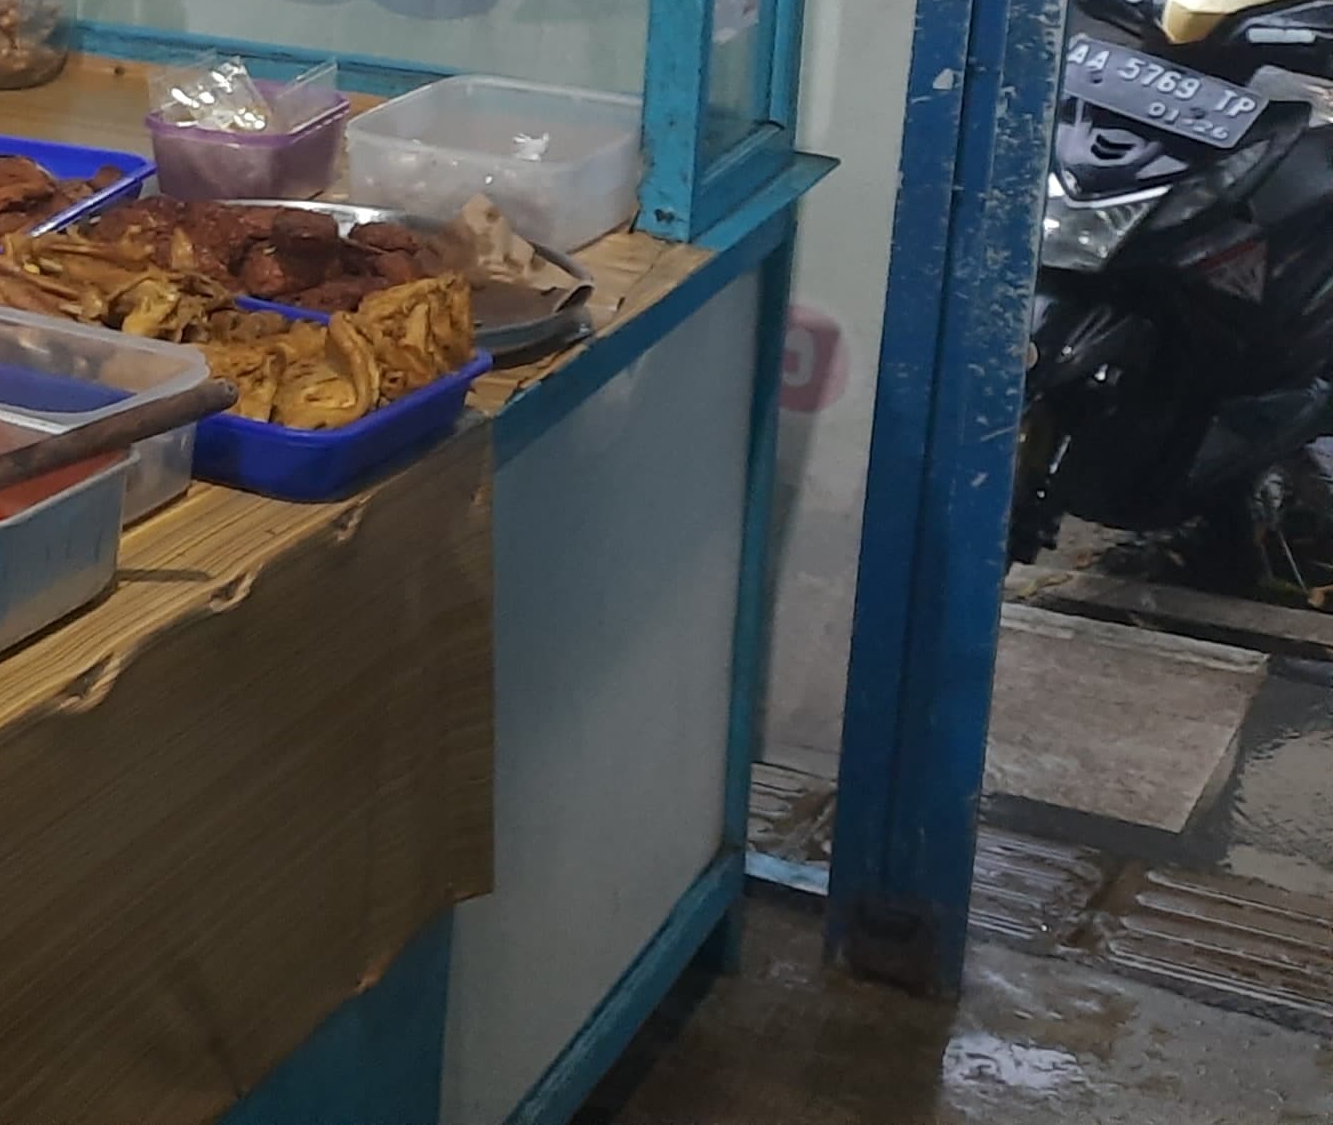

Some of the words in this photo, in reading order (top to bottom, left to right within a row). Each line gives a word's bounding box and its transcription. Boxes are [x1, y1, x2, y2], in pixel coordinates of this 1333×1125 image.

[1067, 43, 1111, 71] AA
[1117, 57, 1201, 100] 5769
[1212, 88, 1257, 117] TP
